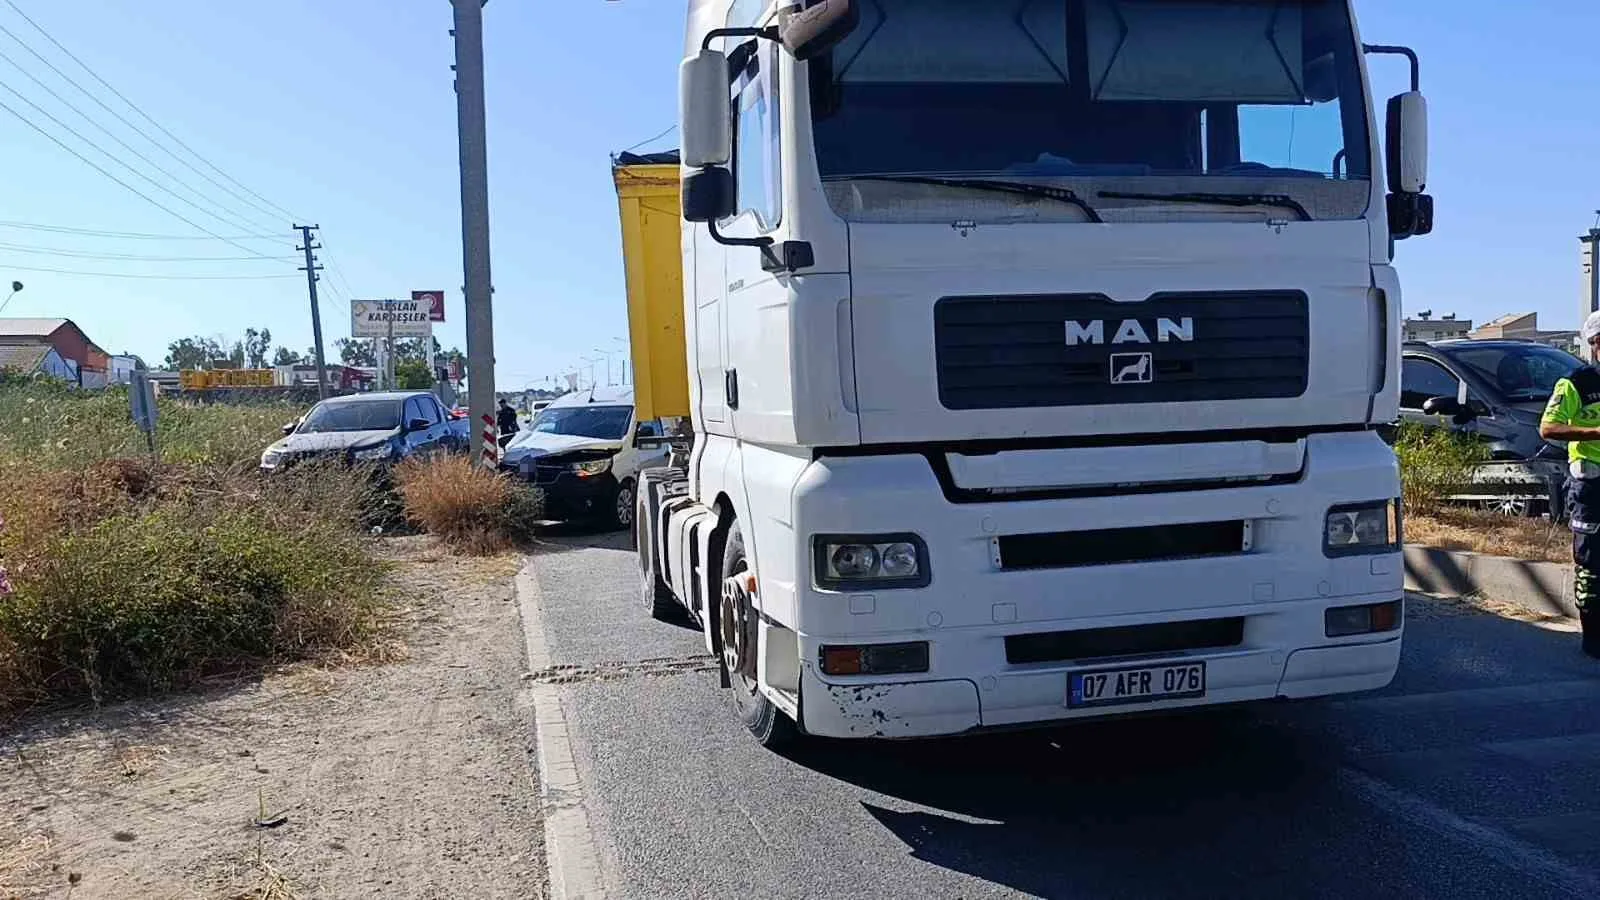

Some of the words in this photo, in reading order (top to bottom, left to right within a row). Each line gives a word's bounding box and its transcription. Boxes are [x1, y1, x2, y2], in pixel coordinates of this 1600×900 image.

[368, 312, 426, 324] KARDEŞLER
[1065, 317, 1194, 346] MAN
[1083, 675, 1108, 699] 07
[1115, 671, 1152, 696] AFR
[1163, 667, 1200, 691] 076
